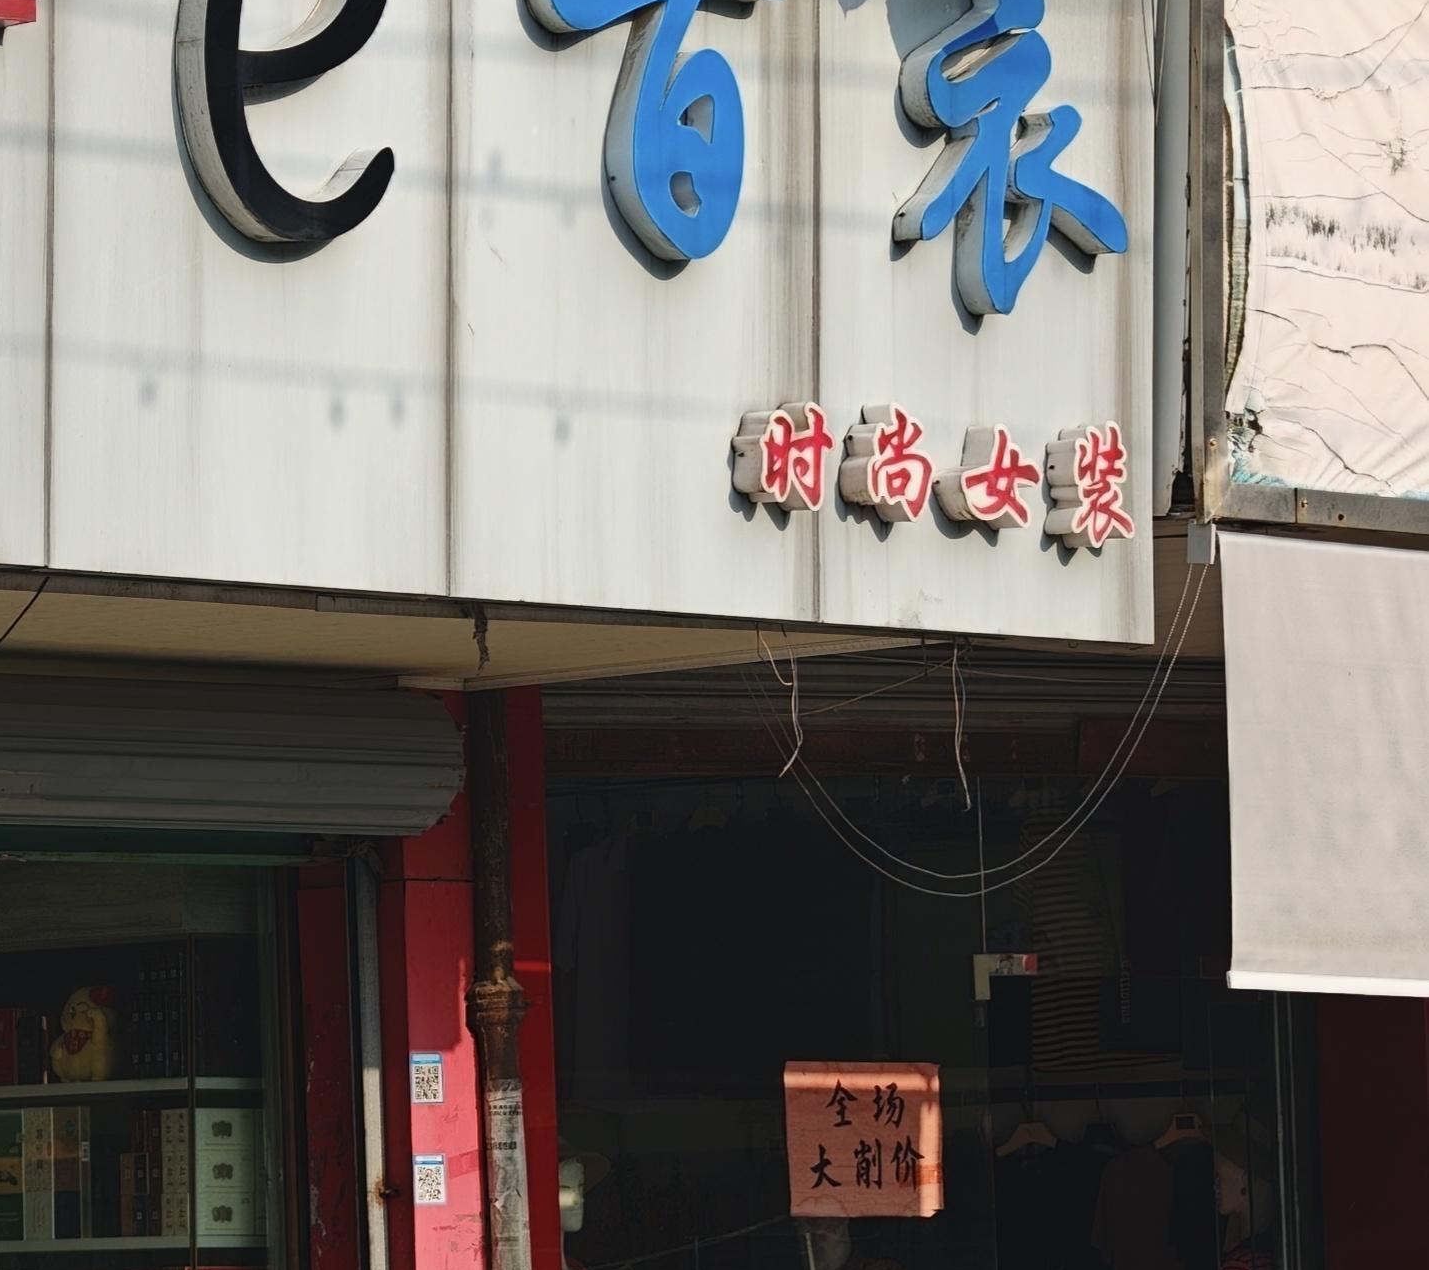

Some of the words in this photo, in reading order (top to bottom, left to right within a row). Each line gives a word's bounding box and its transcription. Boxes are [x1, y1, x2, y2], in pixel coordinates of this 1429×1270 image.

[733, 401, 1134, 548] 时尚女装
[826, 1079, 906, 1128] 全场
[810, 1135, 925, 1194] 大削价
